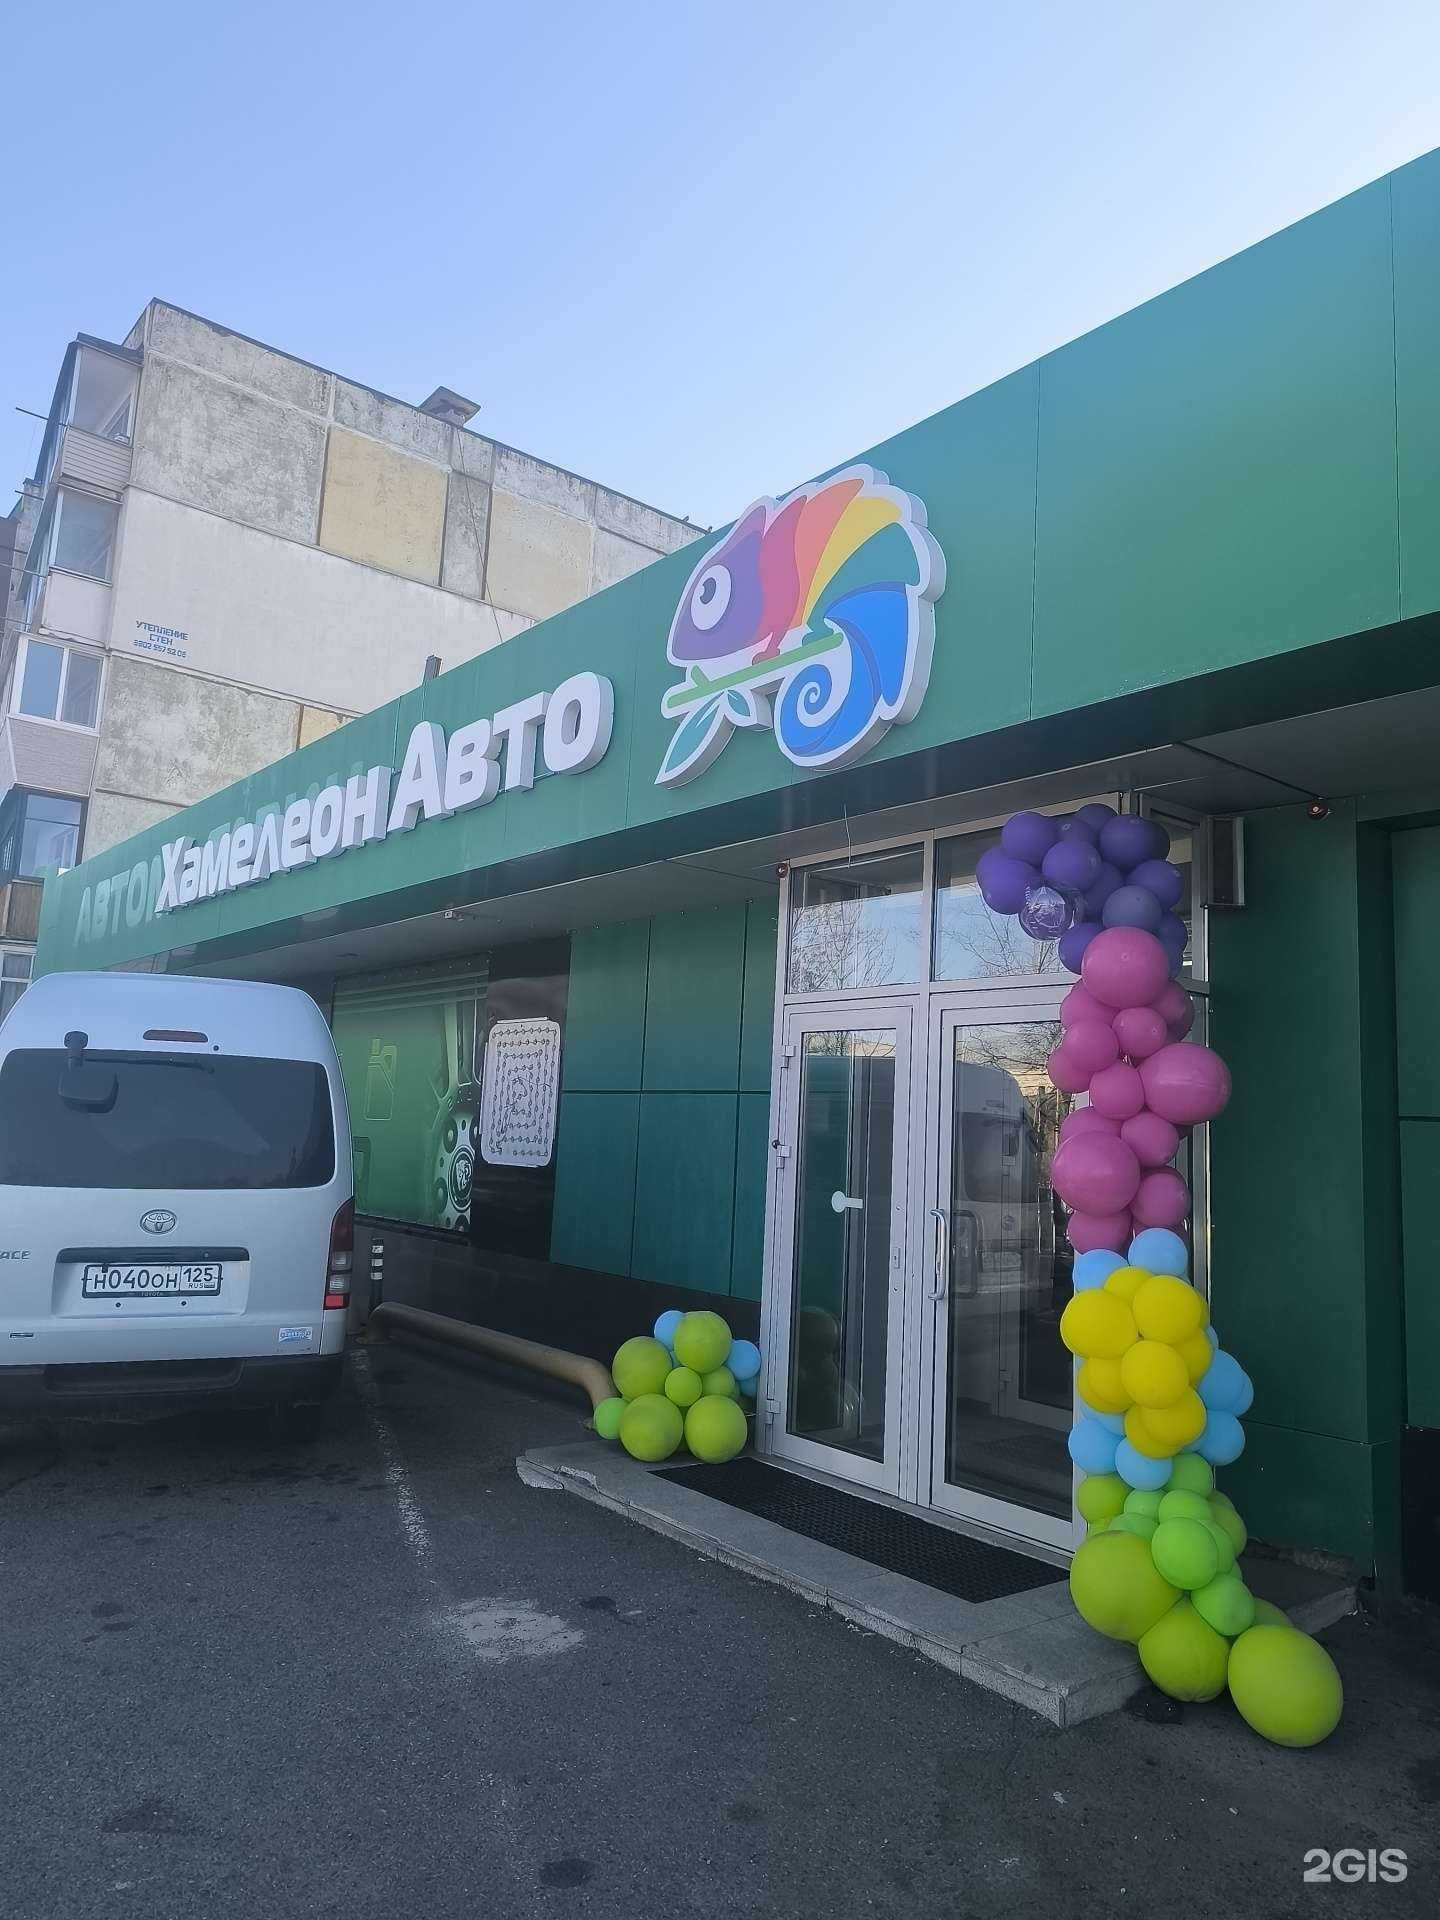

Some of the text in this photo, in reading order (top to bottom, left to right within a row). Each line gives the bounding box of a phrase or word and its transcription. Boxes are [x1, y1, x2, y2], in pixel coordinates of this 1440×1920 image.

[136, 620, 190, 641] УТЕПЛЕНИЕ
[149, 634, 173, 646] СТЕН
[183, 1267, 214, 1283] 125
